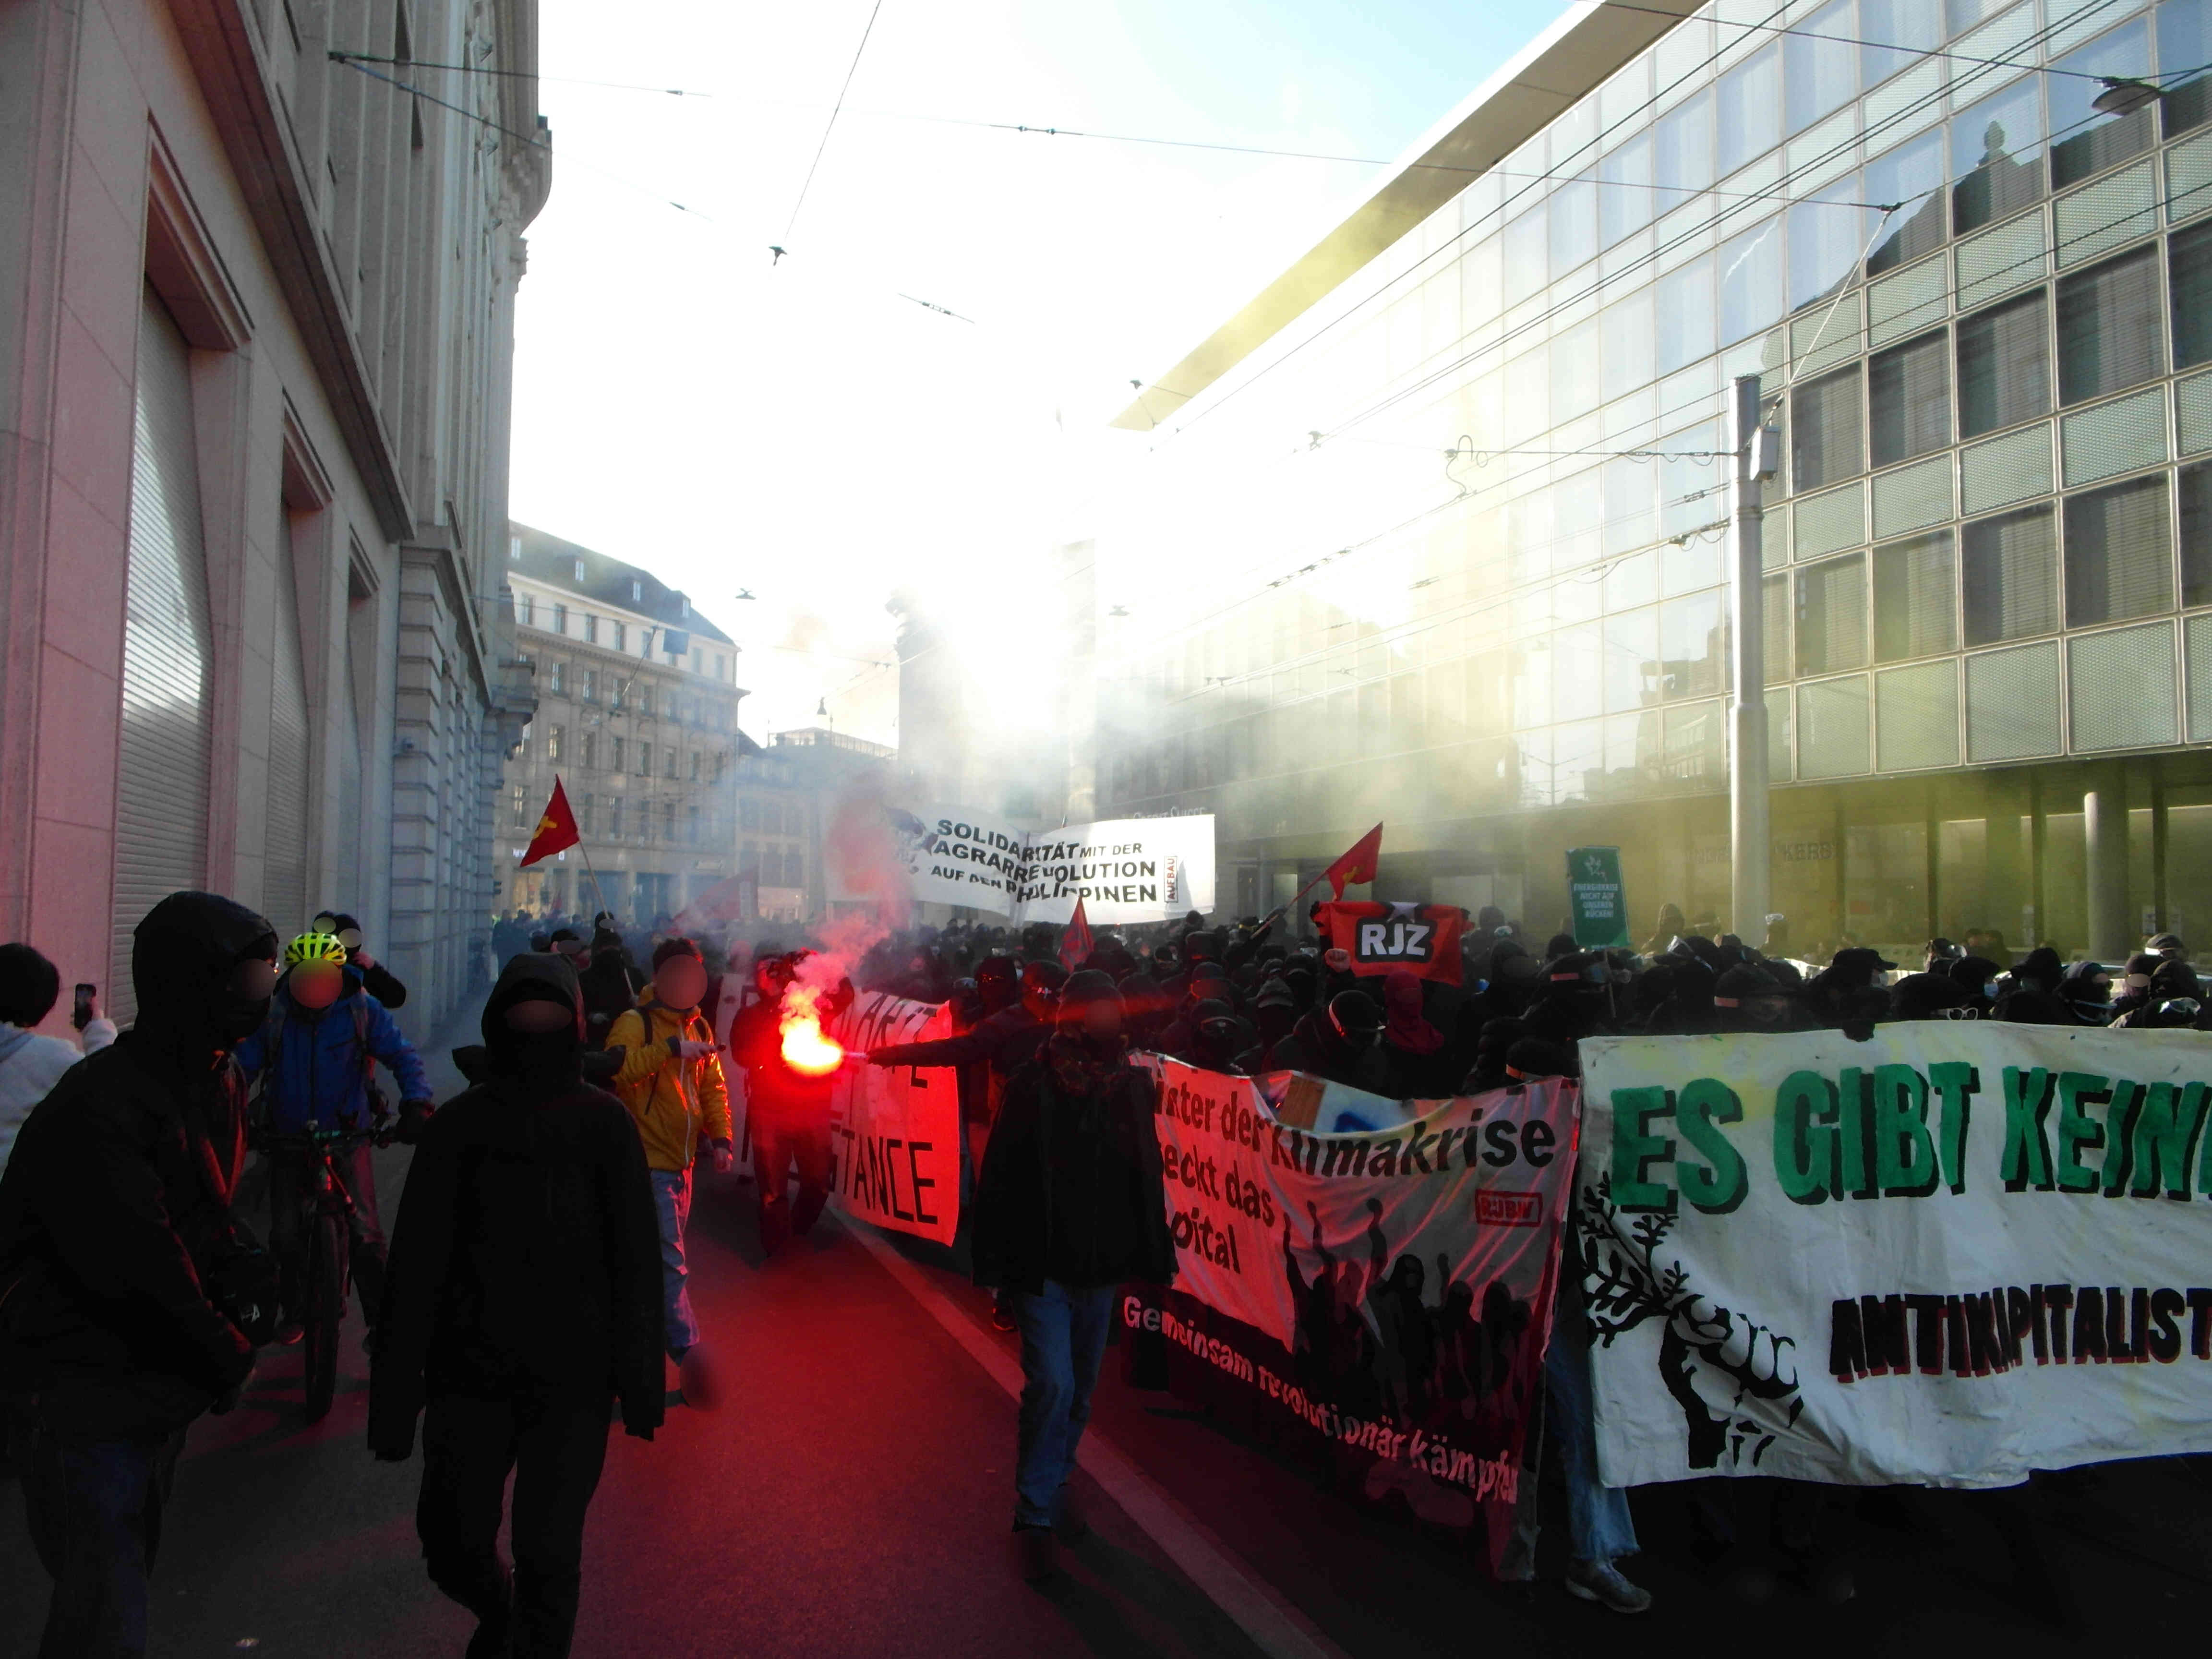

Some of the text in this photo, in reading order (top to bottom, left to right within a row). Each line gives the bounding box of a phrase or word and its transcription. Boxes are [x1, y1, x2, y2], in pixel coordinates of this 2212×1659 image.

[933, 840, 1155, 884] AGRARREVOLUTION
[937, 819, 1142, 862] SOLIDARITÄT MIT DER
[931, 865, 965, 881] AUF
[969, 873, 1002, 889] DEN
[1167, 857, 1176, 901] AUFBAU
[1361, 923, 1431, 956] RJZ
[1154, 1070, 1556, 1178] inter der Klimakrise
[1610, 1061, 2212, 1214] ES GIBT KEIN
[1164, 1143, 1275, 1228] eckt das
[1171, 1207, 1241, 1274] pital
[1124, 1295, 1254, 1383] Gemeinsam
[1258, 1365, 1407, 1462] revolutionär
